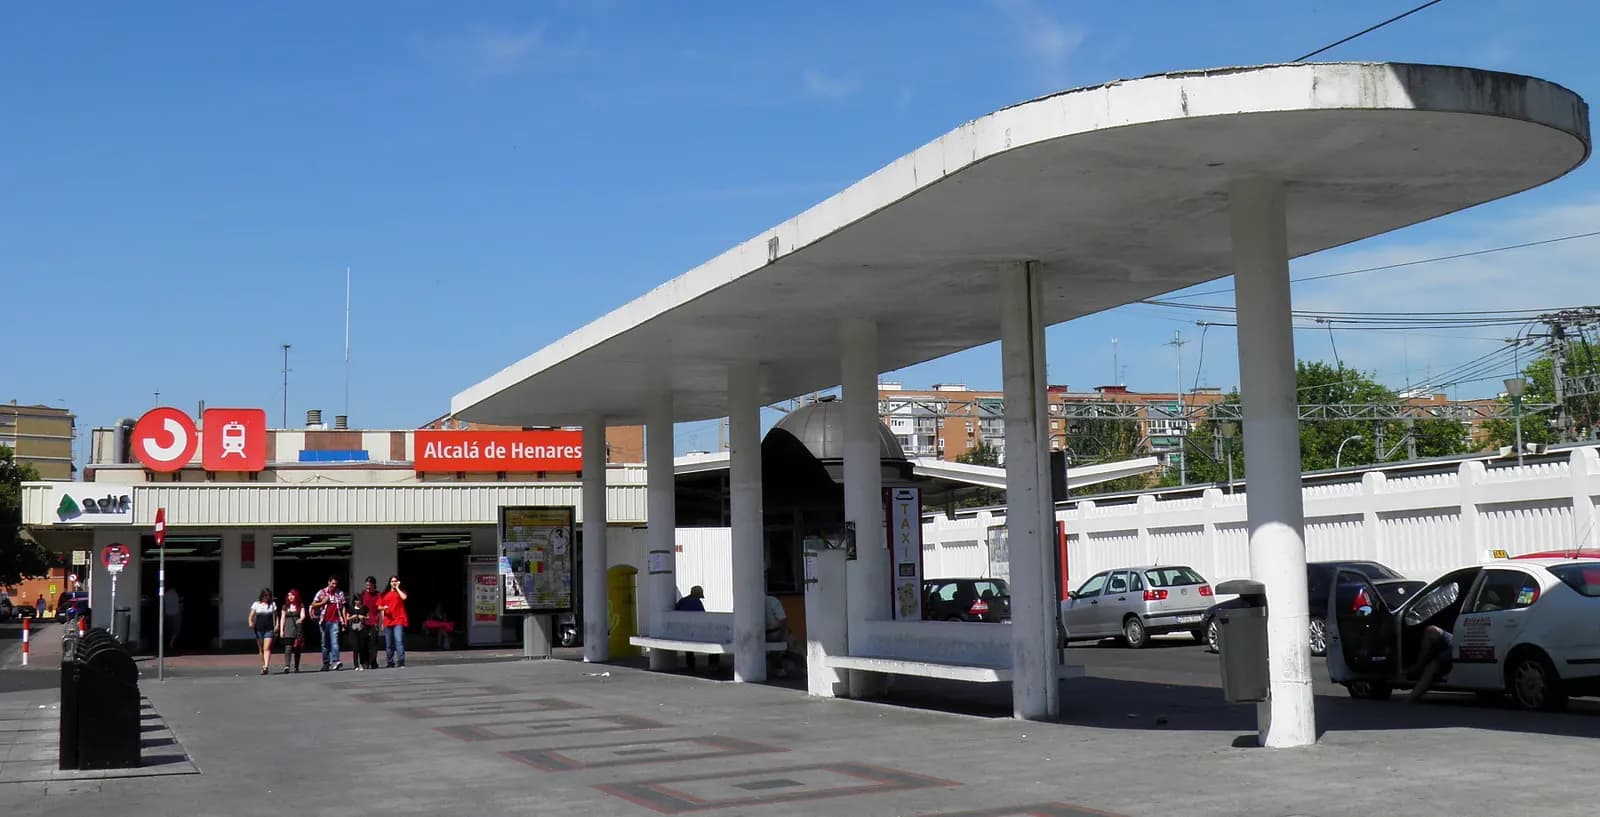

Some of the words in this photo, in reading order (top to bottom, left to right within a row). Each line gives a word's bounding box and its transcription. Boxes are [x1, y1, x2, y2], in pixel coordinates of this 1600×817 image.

[424, 441, 479, 459] Alcalá
[484, 441, 506, 459] de
[511, 442, 582, 459] Henares
[82, 494, 131, 514] adif
[901, 504, 910, 558] TAXI
